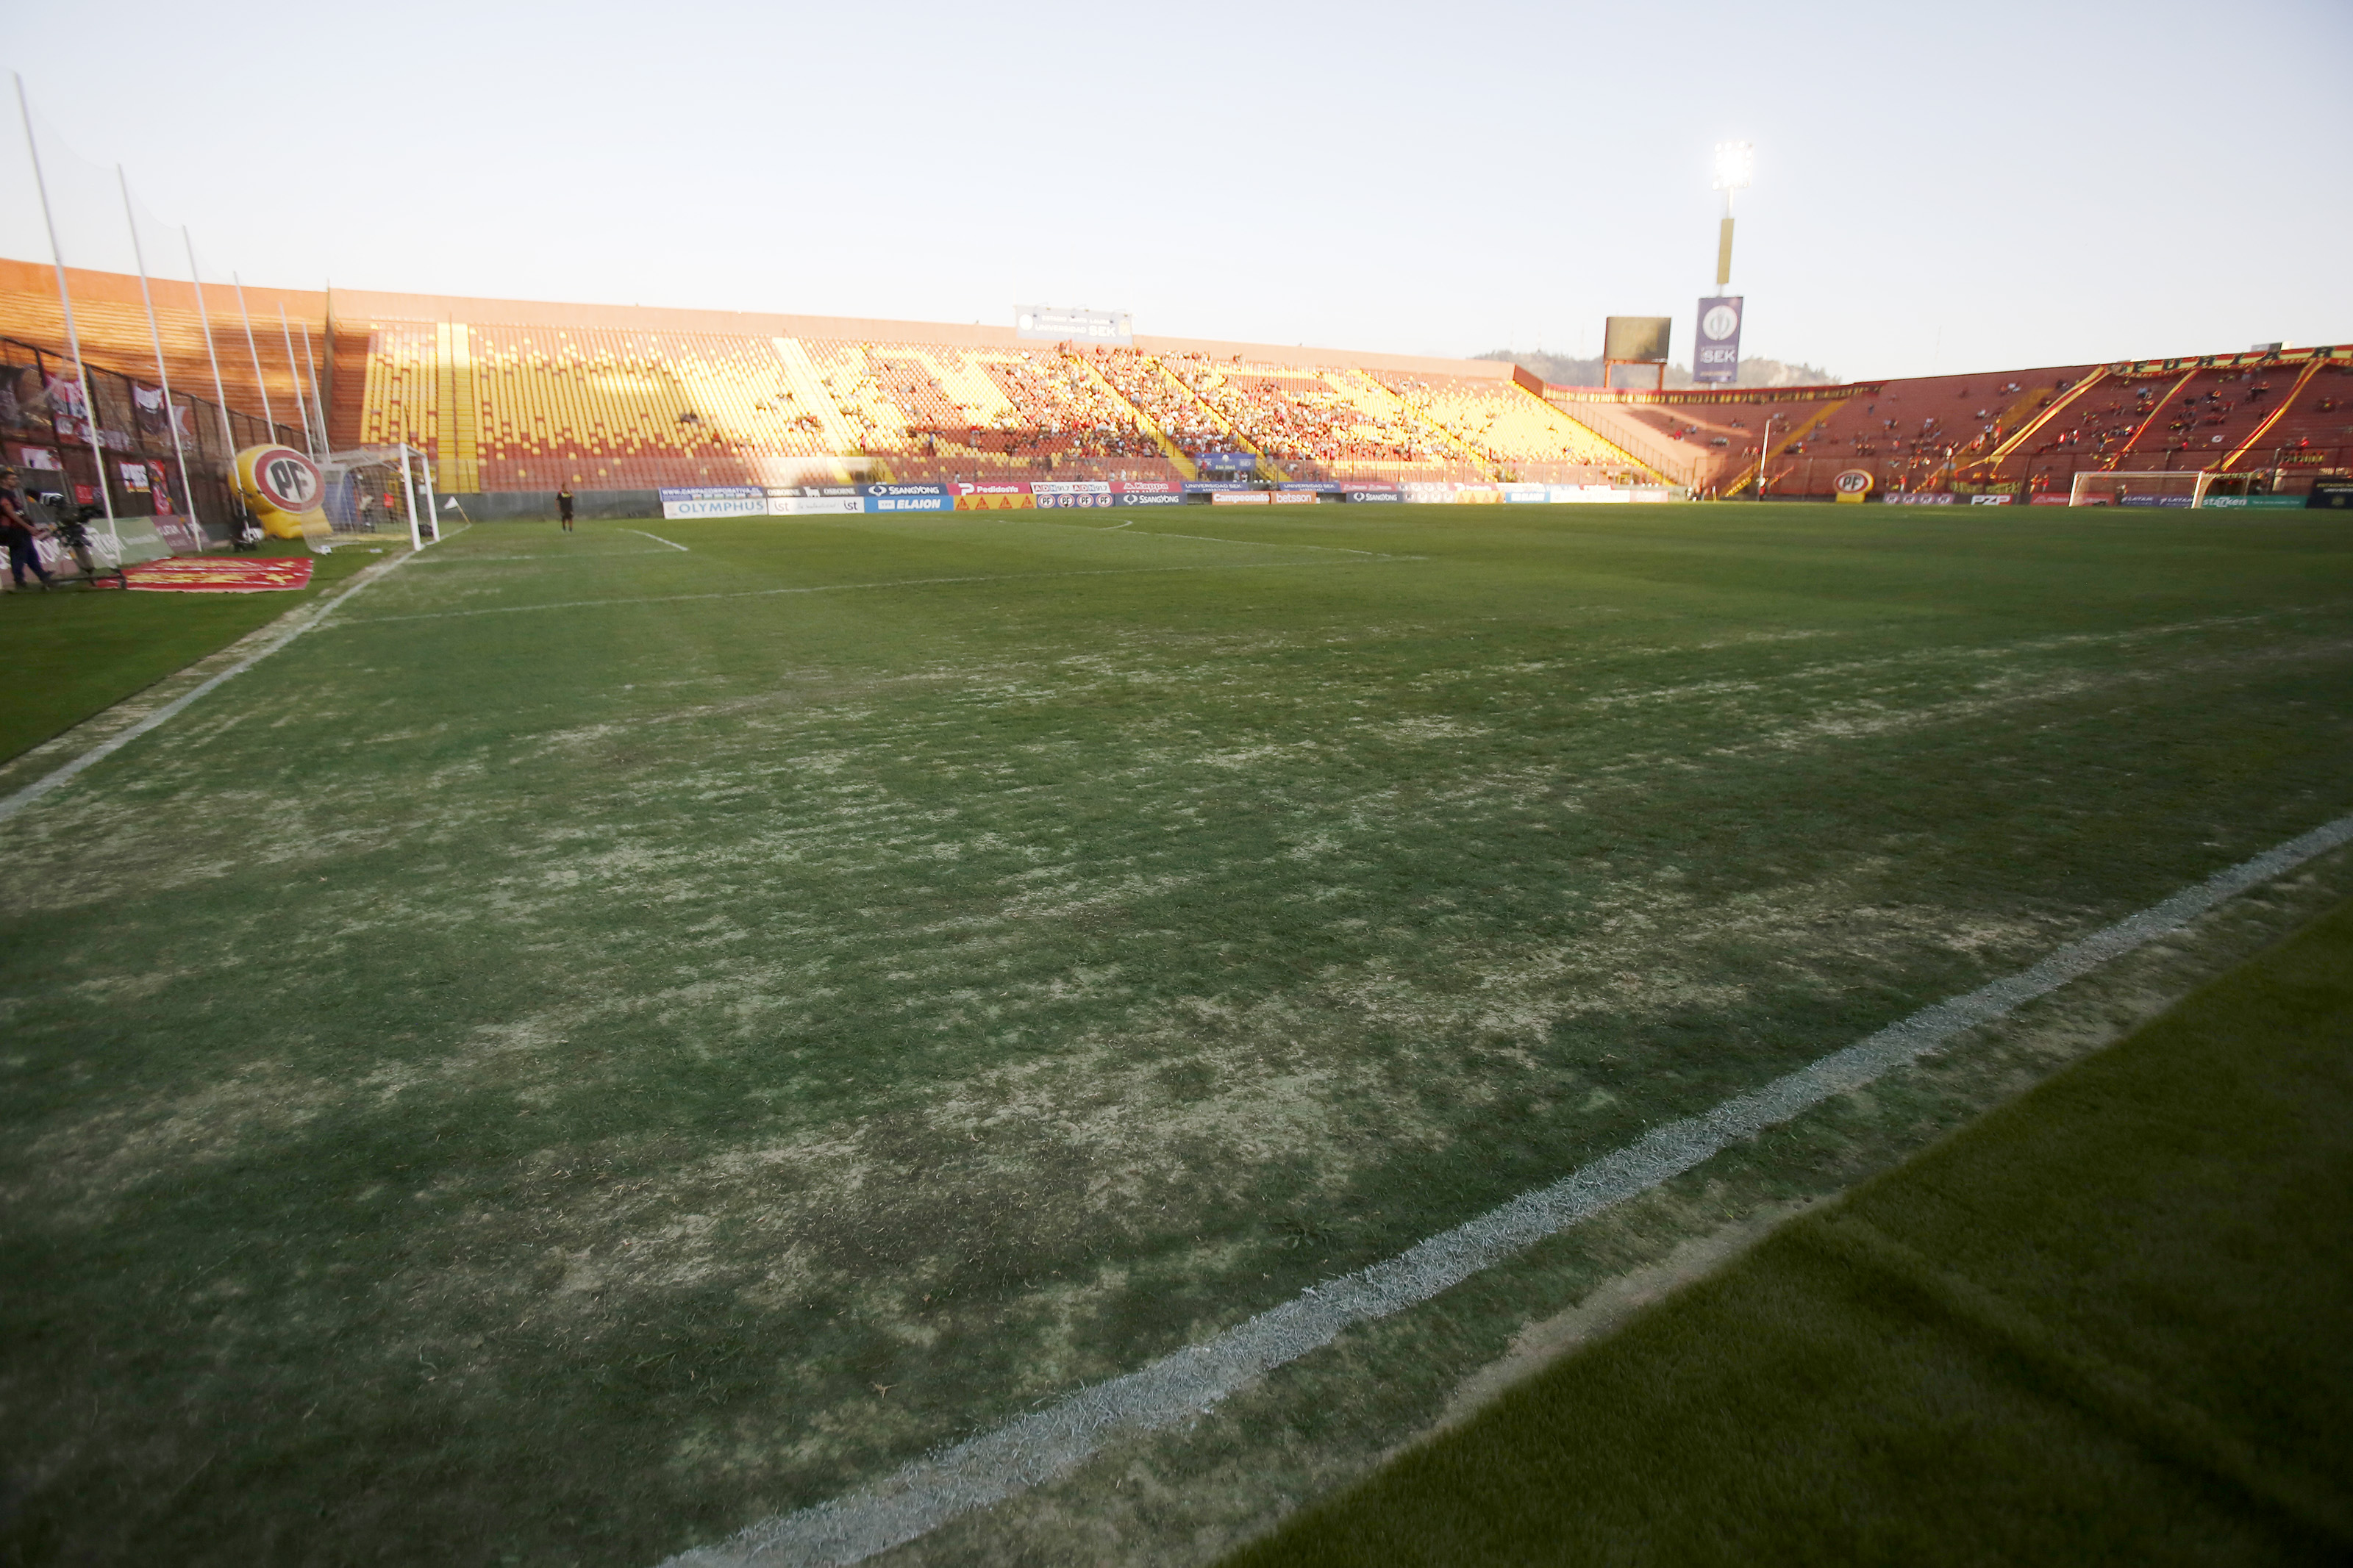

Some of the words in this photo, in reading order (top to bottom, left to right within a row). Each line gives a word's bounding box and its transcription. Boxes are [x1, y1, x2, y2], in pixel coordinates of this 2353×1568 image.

[1035, 323, 1087, 334] UNIVERSIDAD
[1088, 325, 1117, 337] SEK
[1702, 349, 1736, 363] SEK
[270, 460, 307, 501] PF
[1843, 476, 1861, 490] PF
[976, 485, 1018, 493] PedidosYa
[1213, 493, 1270, 503] Campeonato
[1276, 493, 1312, 502] betsson
[1971, 495, 2010, 505] PZP
[2203, 496, 2248, 508] starken
[679, 501, 764, 513] OLYMPHUS
[843, 500, 857, 510] ist
[896, 499, 940, 509] ELAION
